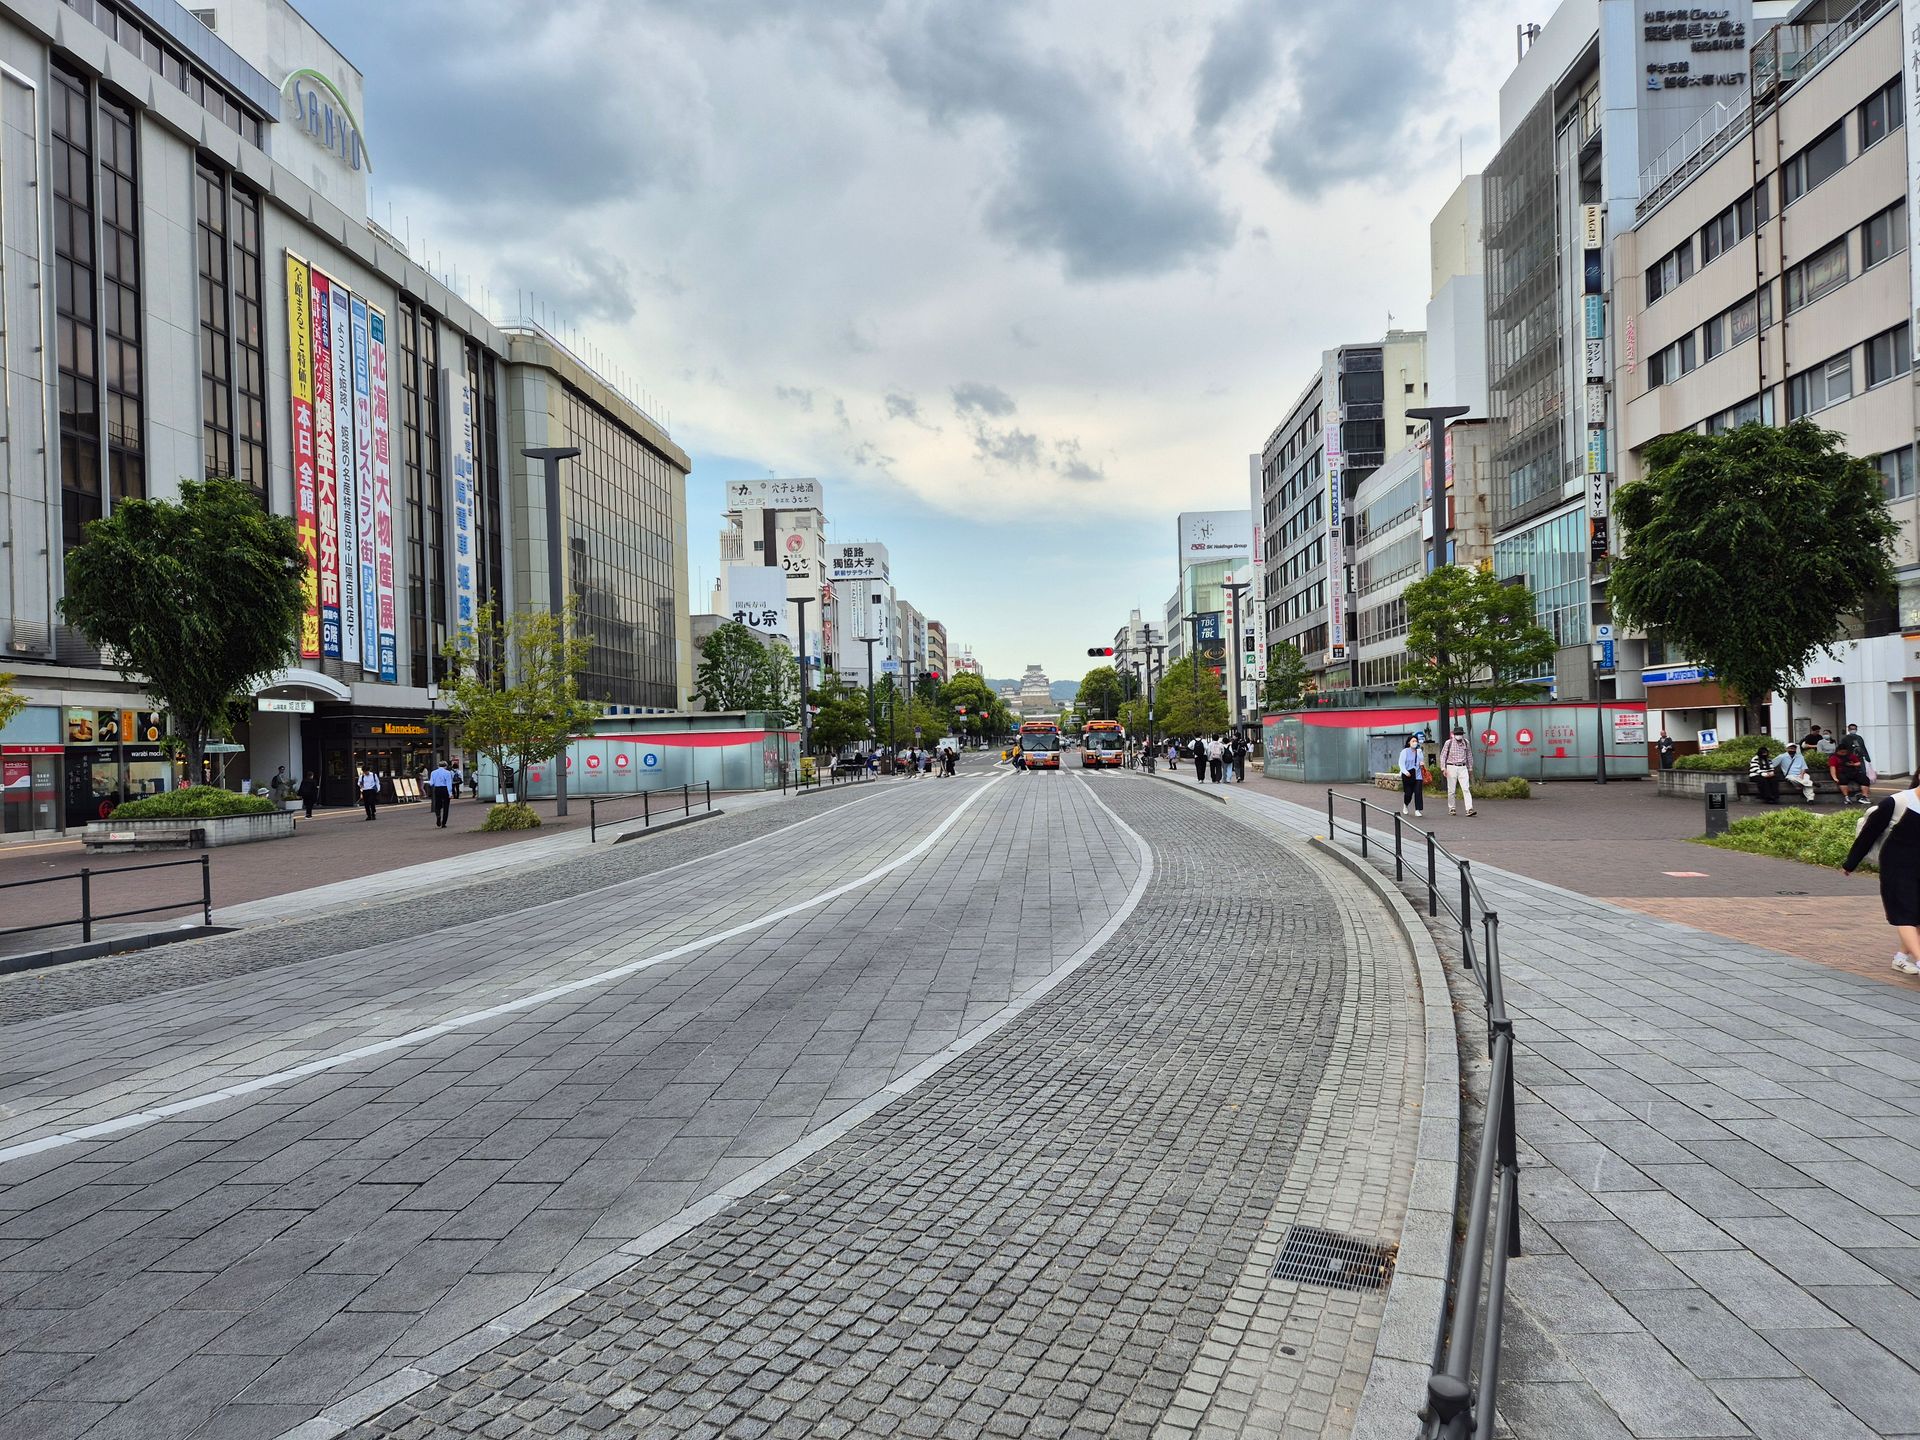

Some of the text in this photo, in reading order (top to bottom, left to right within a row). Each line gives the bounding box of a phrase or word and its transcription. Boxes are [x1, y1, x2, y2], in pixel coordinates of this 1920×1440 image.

[295, 80, 361, 171] SANYO
[297, 404, 311, 457] 本日
[299, 462, 314, 515] 全館
[371, 342, 394, 630] 北海道大物産展
[771, 482, 814, 494] 穴子と地酒
[360, 429, 374, 564] レストラン街
[843, 547, 864, 558] 姫路
[833, 558, 875, 569] 獨協大学
[732, 610, 778, 627] すし宗
[1201, 619, 1215, 627] TBC
[323, 624, 338, 643] 6階
[1201, 631, 1215, 639] TBC
[382, 649, 394, 666] 6階
[1668, 669, 1696, 681] LAWSON
[385, 723, 420, 734] Manneken
[1545, 729, 1575, 737] FESTA
